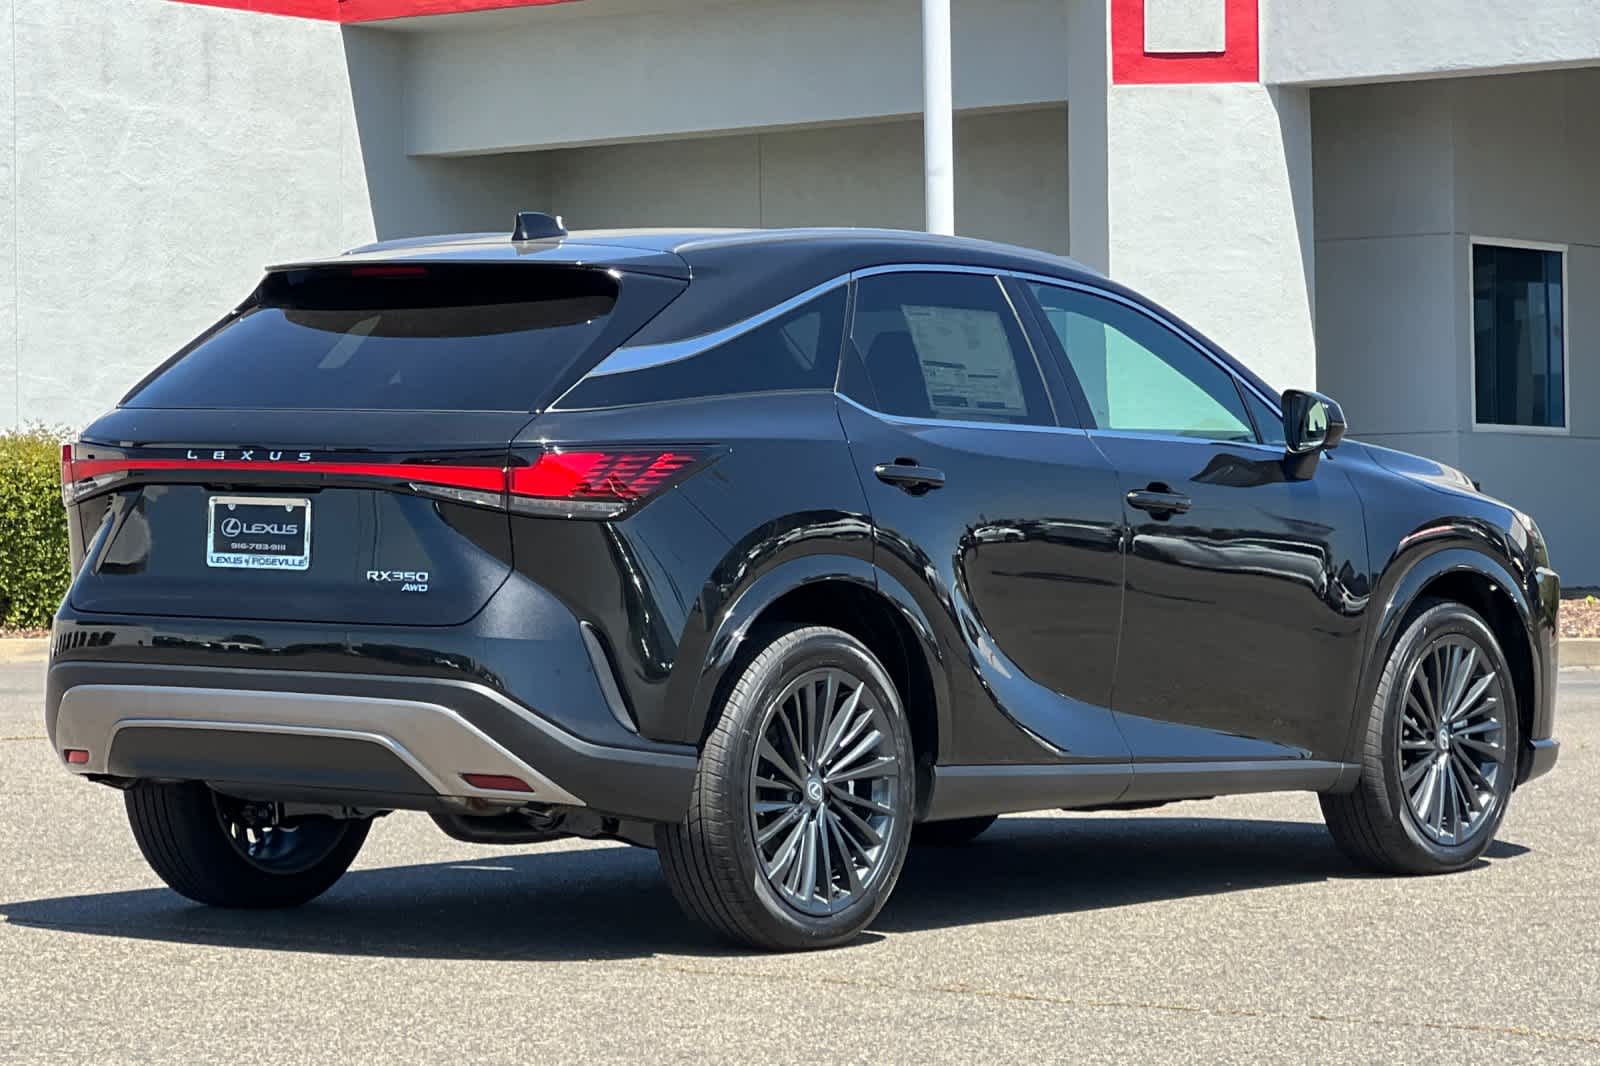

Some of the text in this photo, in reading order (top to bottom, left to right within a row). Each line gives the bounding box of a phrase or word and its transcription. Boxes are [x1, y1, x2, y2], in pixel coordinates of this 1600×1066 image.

[186, 450, 312, 462] LEXUS
[242, 523, 298, 535] LEXUS
[210, 555, 241, 564] LEXUS
[251, 556, 305, 567] ROSEVILLE
[401, 583, 428, 592] AWD
